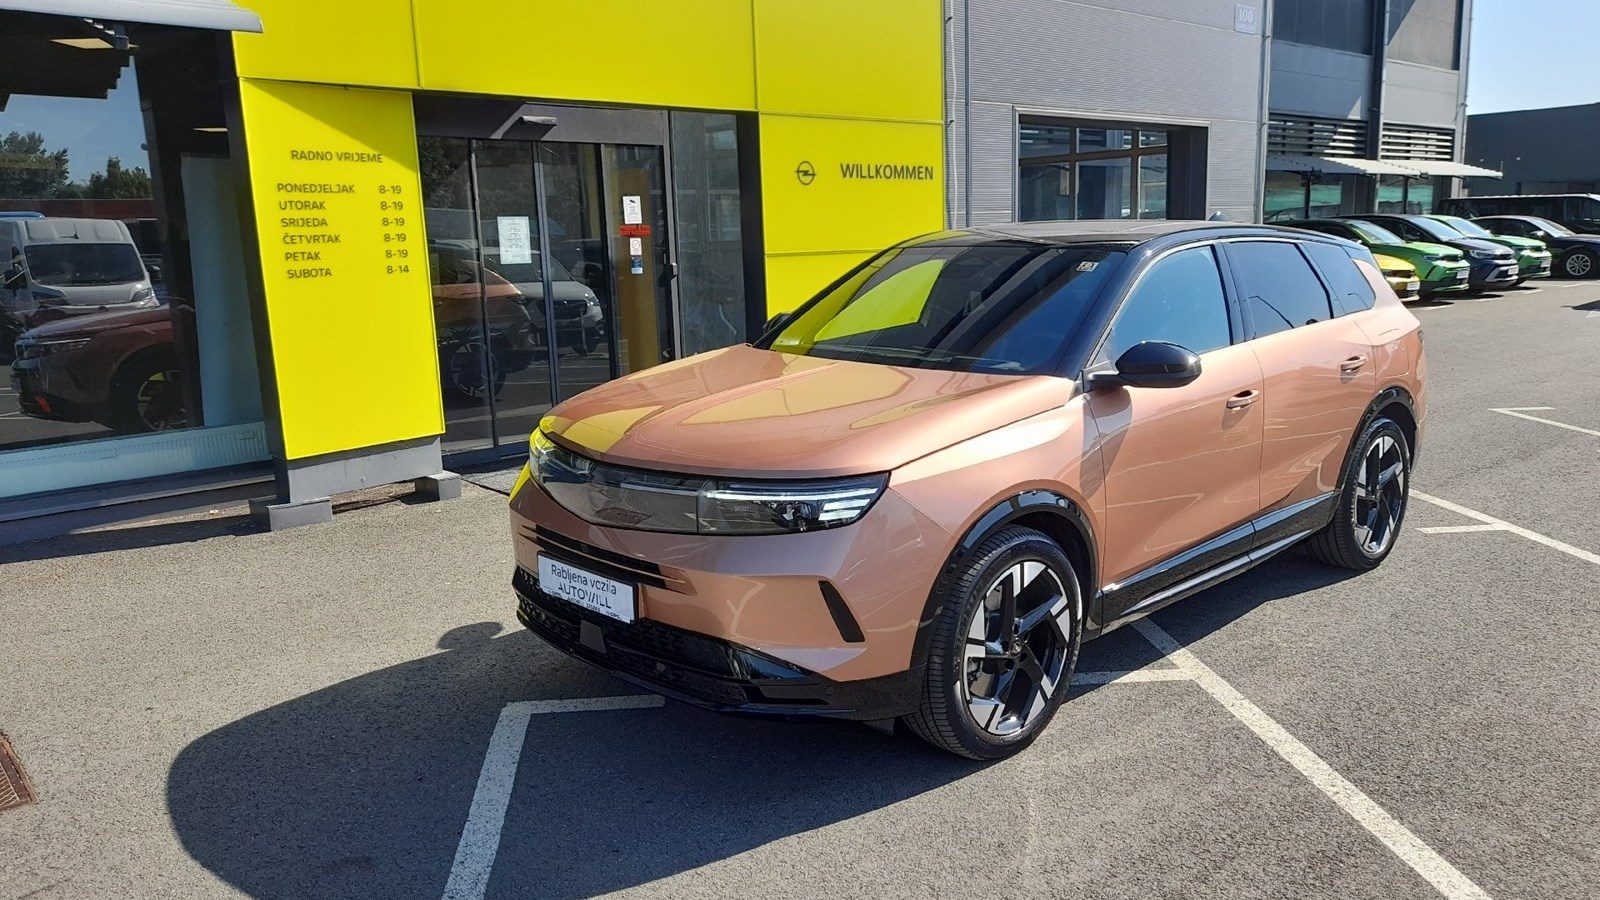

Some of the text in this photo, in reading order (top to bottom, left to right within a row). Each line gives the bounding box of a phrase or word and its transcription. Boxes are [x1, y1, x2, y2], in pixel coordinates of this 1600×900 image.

[291, 150, 383, 163] RADNO VRIJEME
[840, 163, 934, 180] WILLKOMMEN
[277, 183, 402, 194] PONEDJELJAK 8-19
[279, 200, 404, 211] UTORAK 8-19
[281, 217, 405, 228] SRIJEDA 8-19
[283, 233, 407, 245] ČETVRTAK 8-19
[285, 249, 409, 262] PETAK 8-19
[287, 265, 410, 279] SUBOTA 8-14
[551, 564, 588, 586] Rabljena
